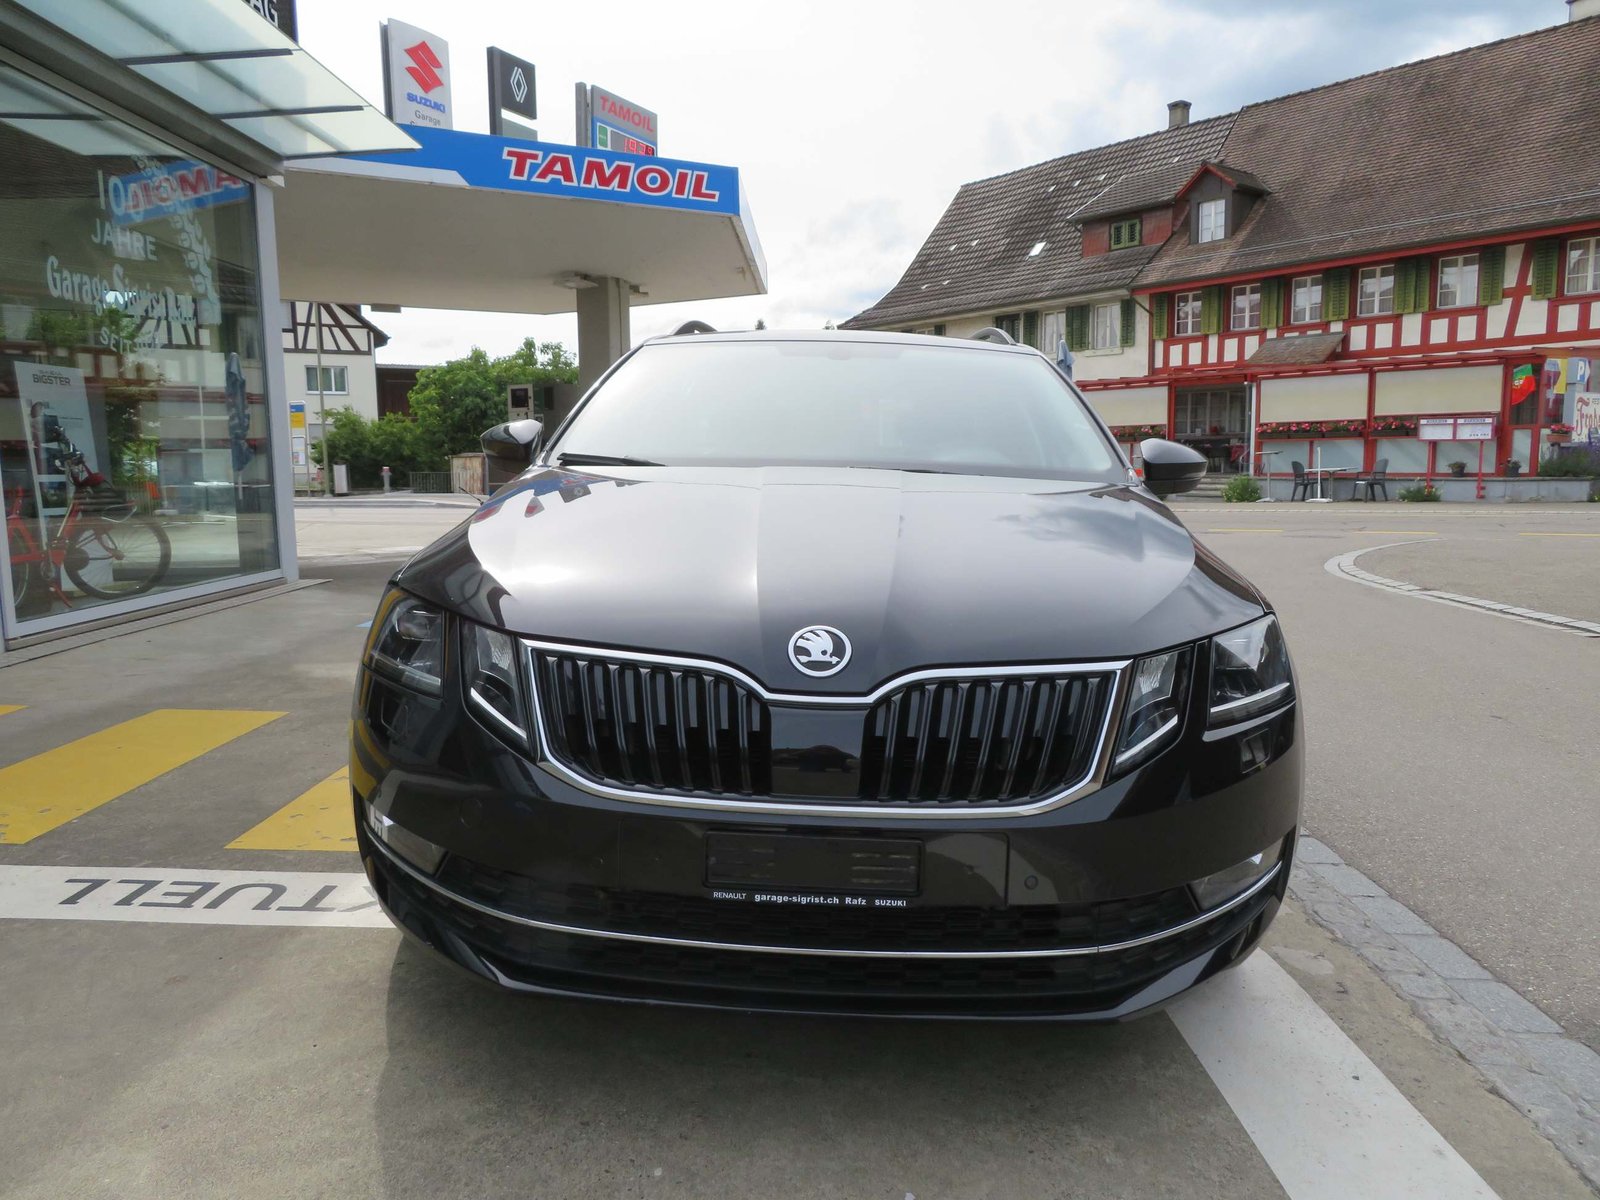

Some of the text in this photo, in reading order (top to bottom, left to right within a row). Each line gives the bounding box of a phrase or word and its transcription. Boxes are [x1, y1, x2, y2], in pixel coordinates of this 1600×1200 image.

[406, 92, 446, 113] SUZUKI
[414, 110, 441, 126] Garage
[600, 96, 654, 133] TAMOIL
[503, 147, 720, 203] TAMOIL
[91, 218, 158, 261] JAHRE
[32, 373, 72, 386] BIGSTER
[1577, 361, 1585, 381] P
[713, 891, 907, 907] RENAULT garage-sigrist.ch Rafz SUZUKI
